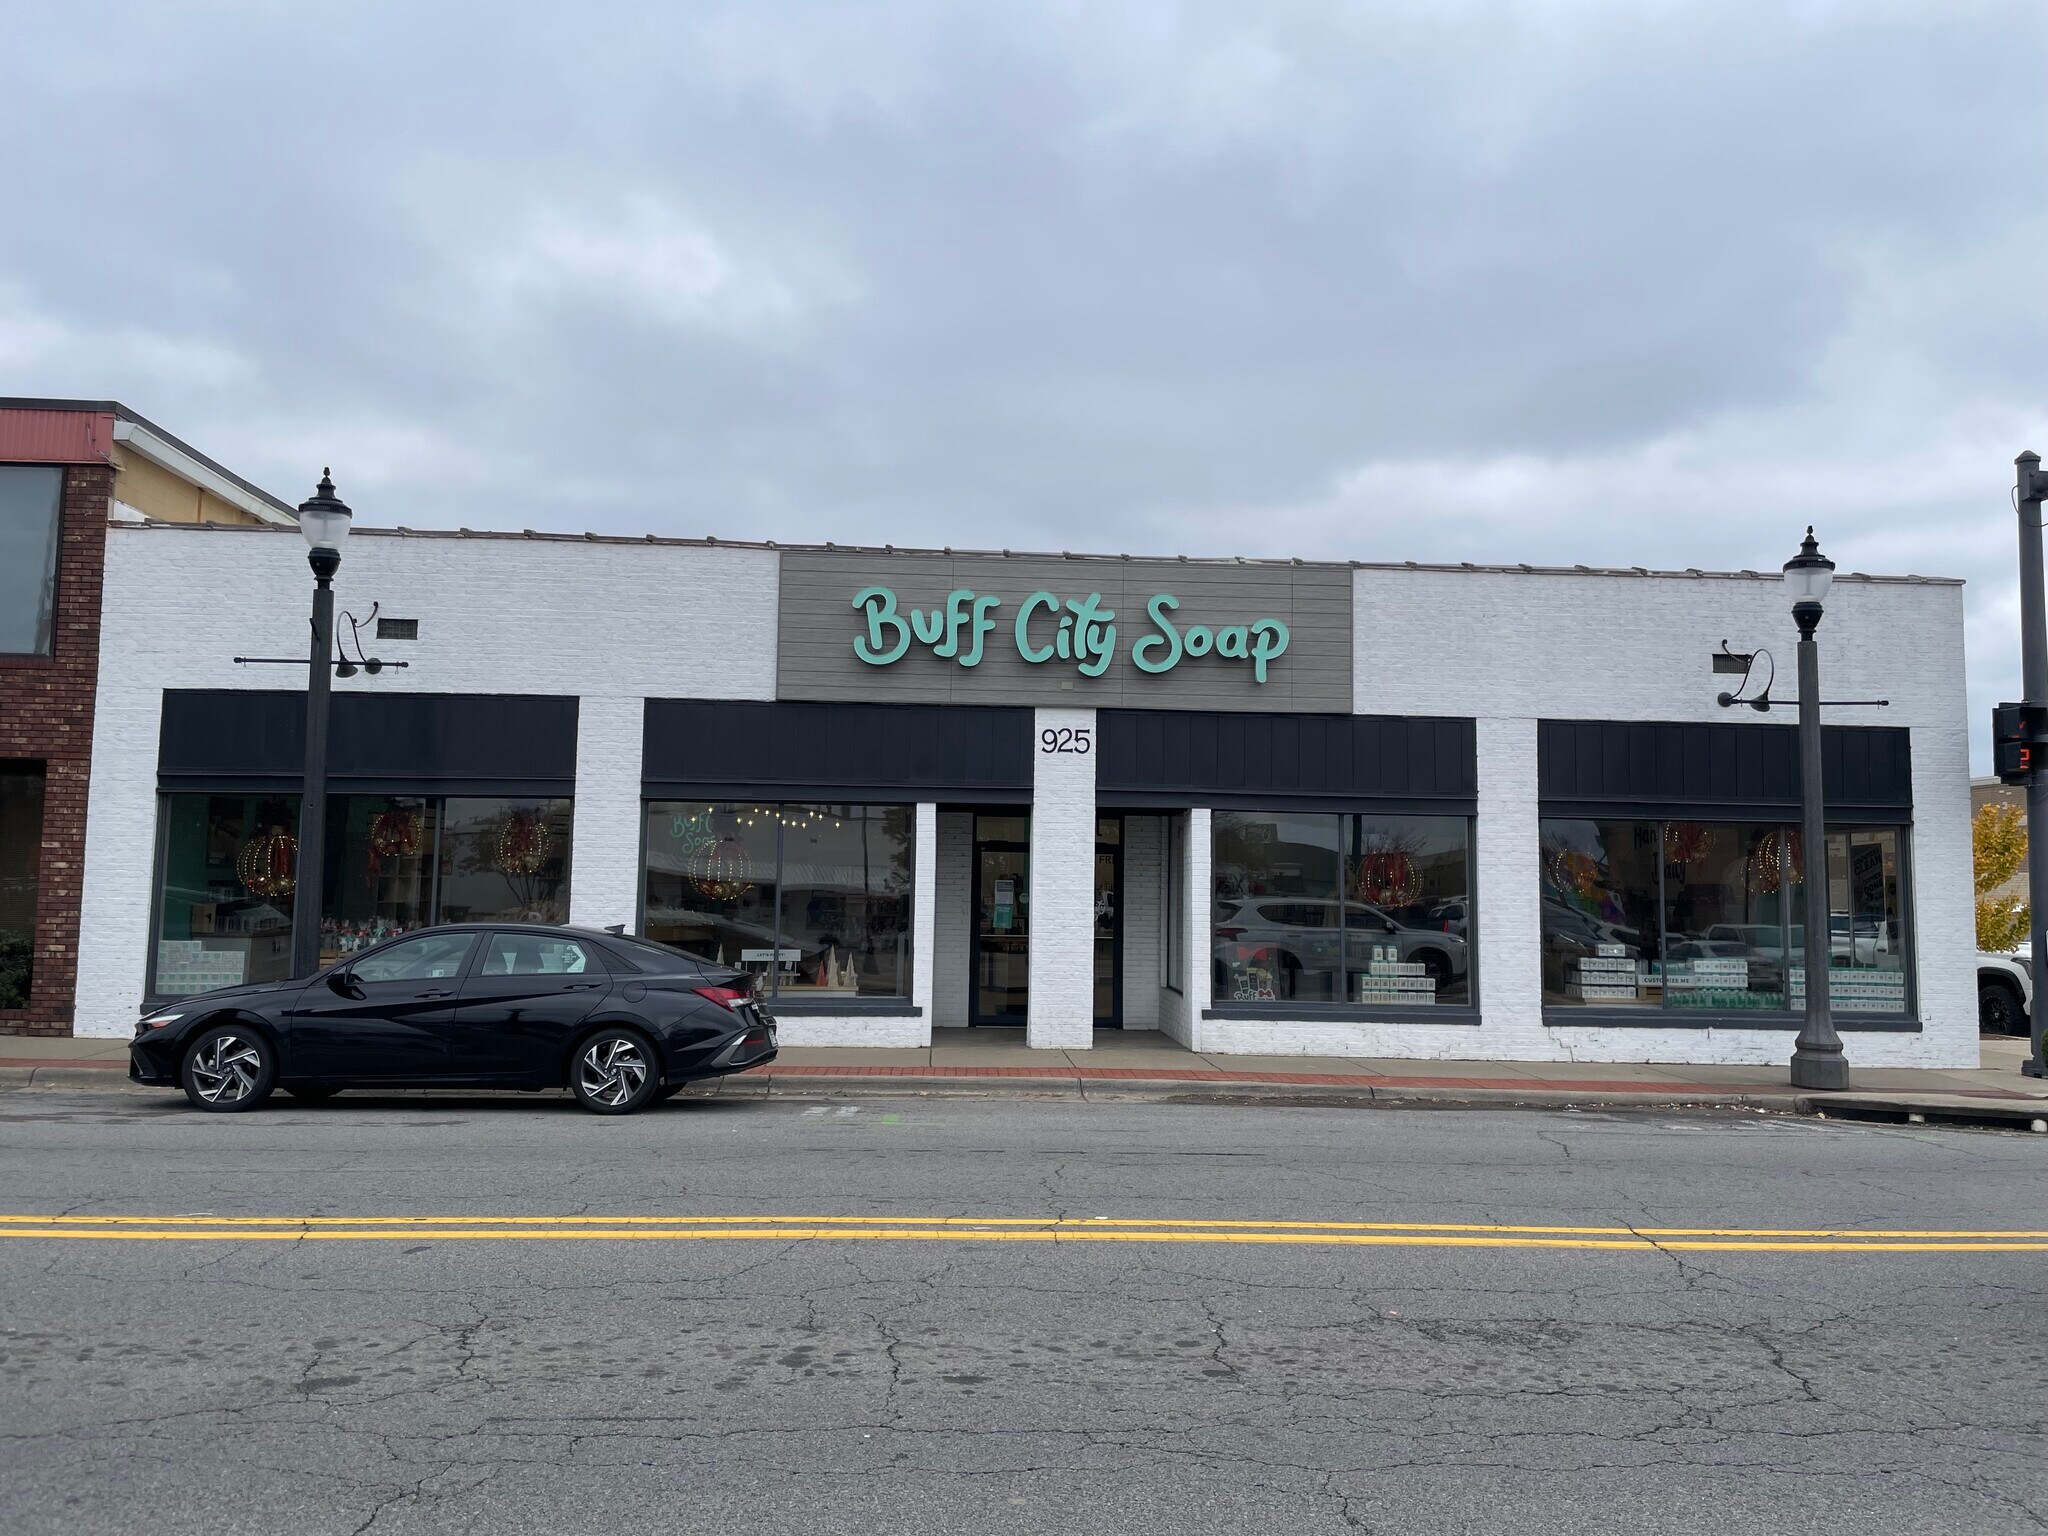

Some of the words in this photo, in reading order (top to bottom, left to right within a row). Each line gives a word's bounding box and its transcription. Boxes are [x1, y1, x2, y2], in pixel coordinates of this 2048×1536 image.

[852, 587, 1001, 668] Buff
[1015, 591, 1117, 677] City
[1132, 594, 1290, 684] Soap
[1041, 728, 1091, 754] 925
[1854, 854, 1883, 876] CLEAN
